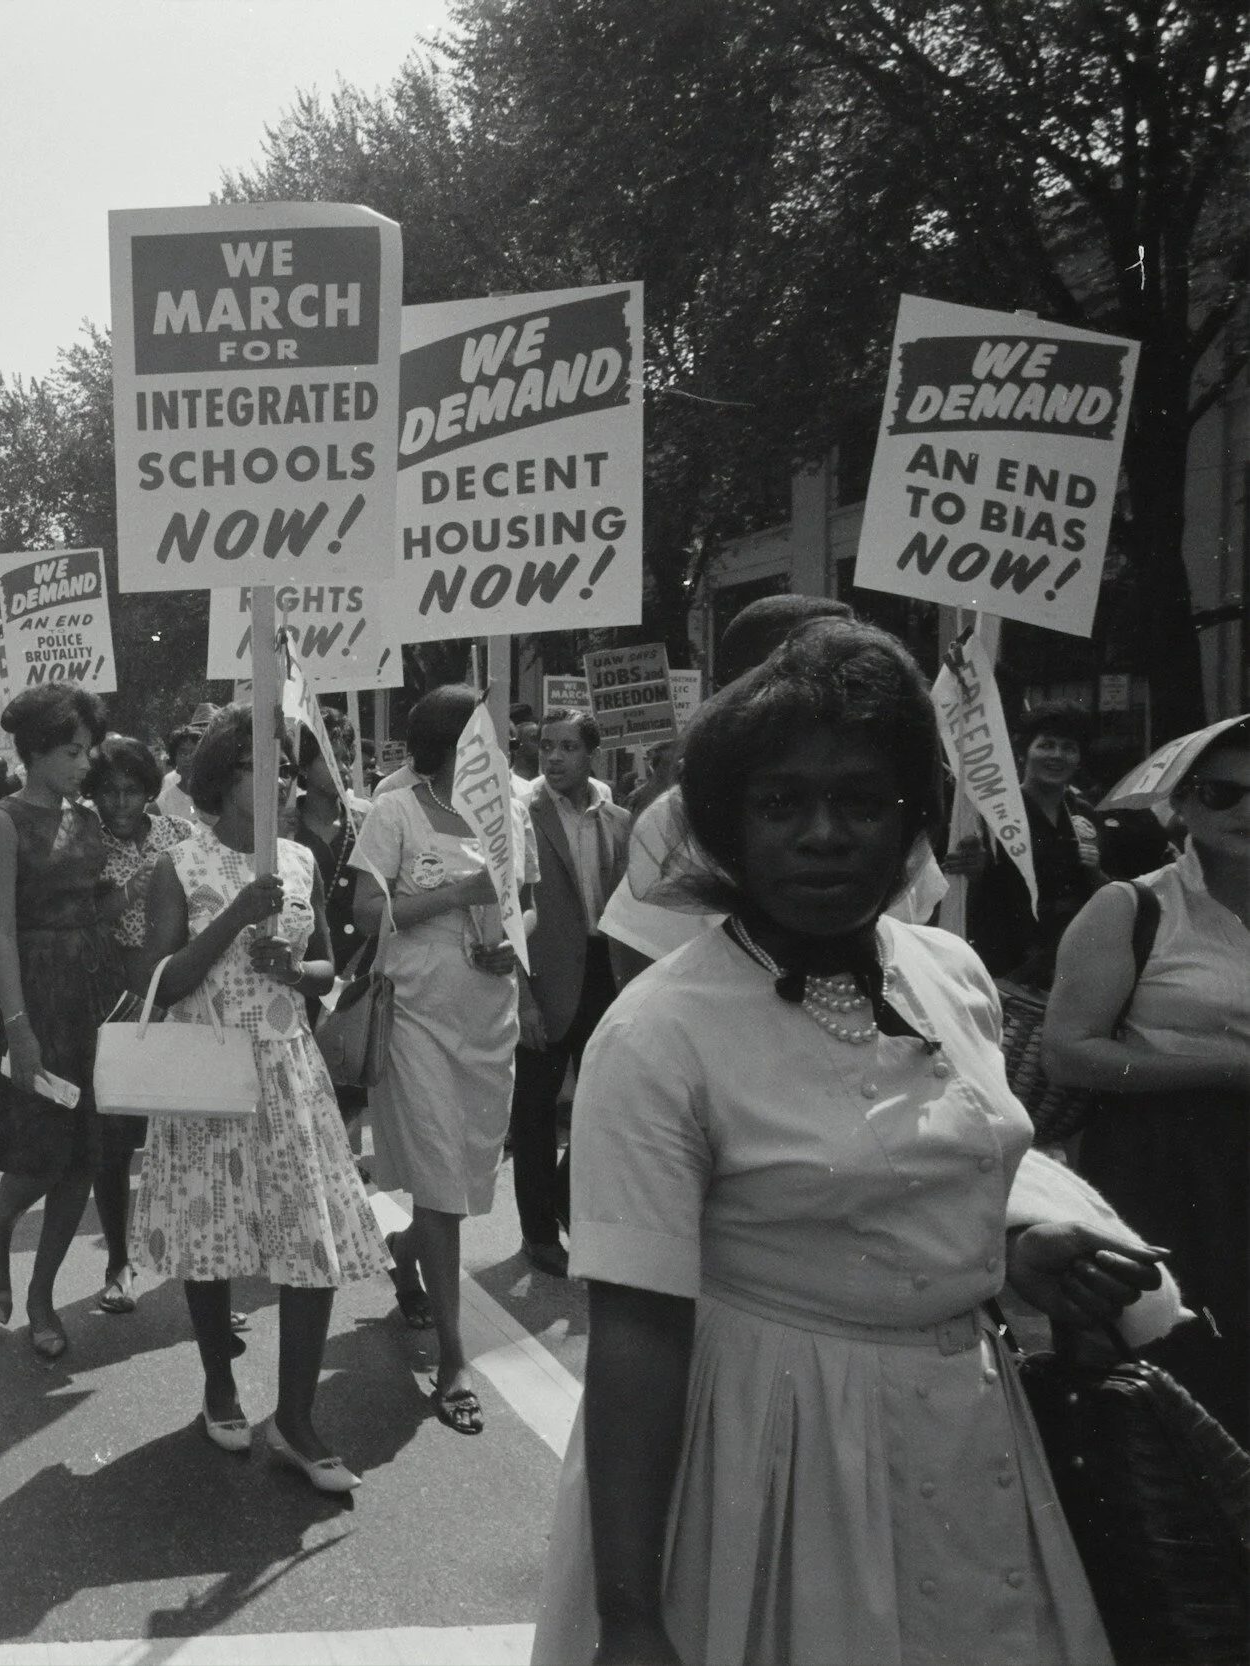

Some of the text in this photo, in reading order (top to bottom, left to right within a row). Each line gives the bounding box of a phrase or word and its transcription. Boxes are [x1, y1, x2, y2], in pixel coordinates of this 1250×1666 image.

[221, 240, 293, 278] WE
[153, 283, 361, 335] MARCH
[219, 339, 299, 362] FOR
[460, 316, 549, 383] WE
[972, 341, 1058, 380] WE
[136, 381, 378, 431] INTEGRATED
[399, 347, 622, 455] DEMAND
[906, 382, 1113, 425] DEMAND
[138, 442, 375, 491] SCHOOLS
[422, 451, 608, 504] DECENT
[905, 443, 1097, 509] AN END
[156, 493, 366, 564] NOW!
[403, 506, 626, 560] HOUSING
[906, 485, 1086, 552] TO BIAS
[34, 558, 68, 584] WE
[419, 544, 616, 616] NOW!
[897, 531, 1081, 601] NOW!
[11, 572, 97, 615] DEMAND
[239, 586, 364, 612] RGHTS
[20, 614, 93, 630] AN END
[38, 634, 82, 648] POLICE
[25, 647, 92, 662] BRUTALITY
[26, 655, 104, 686] NOW!
[593, 650, 657, 667] UAW SAYS
[552, 690, 589, 698] MARCH
[593, 667, 664, 689] JOBS and
[595, 685, 668, 711] FREEDOM
[627, 718, 672, 733] American
[455, 734, 509, 871] FREEDOM
[993, 802, 1008, 820] IN
[1000, 819, 1027, 857] '63
